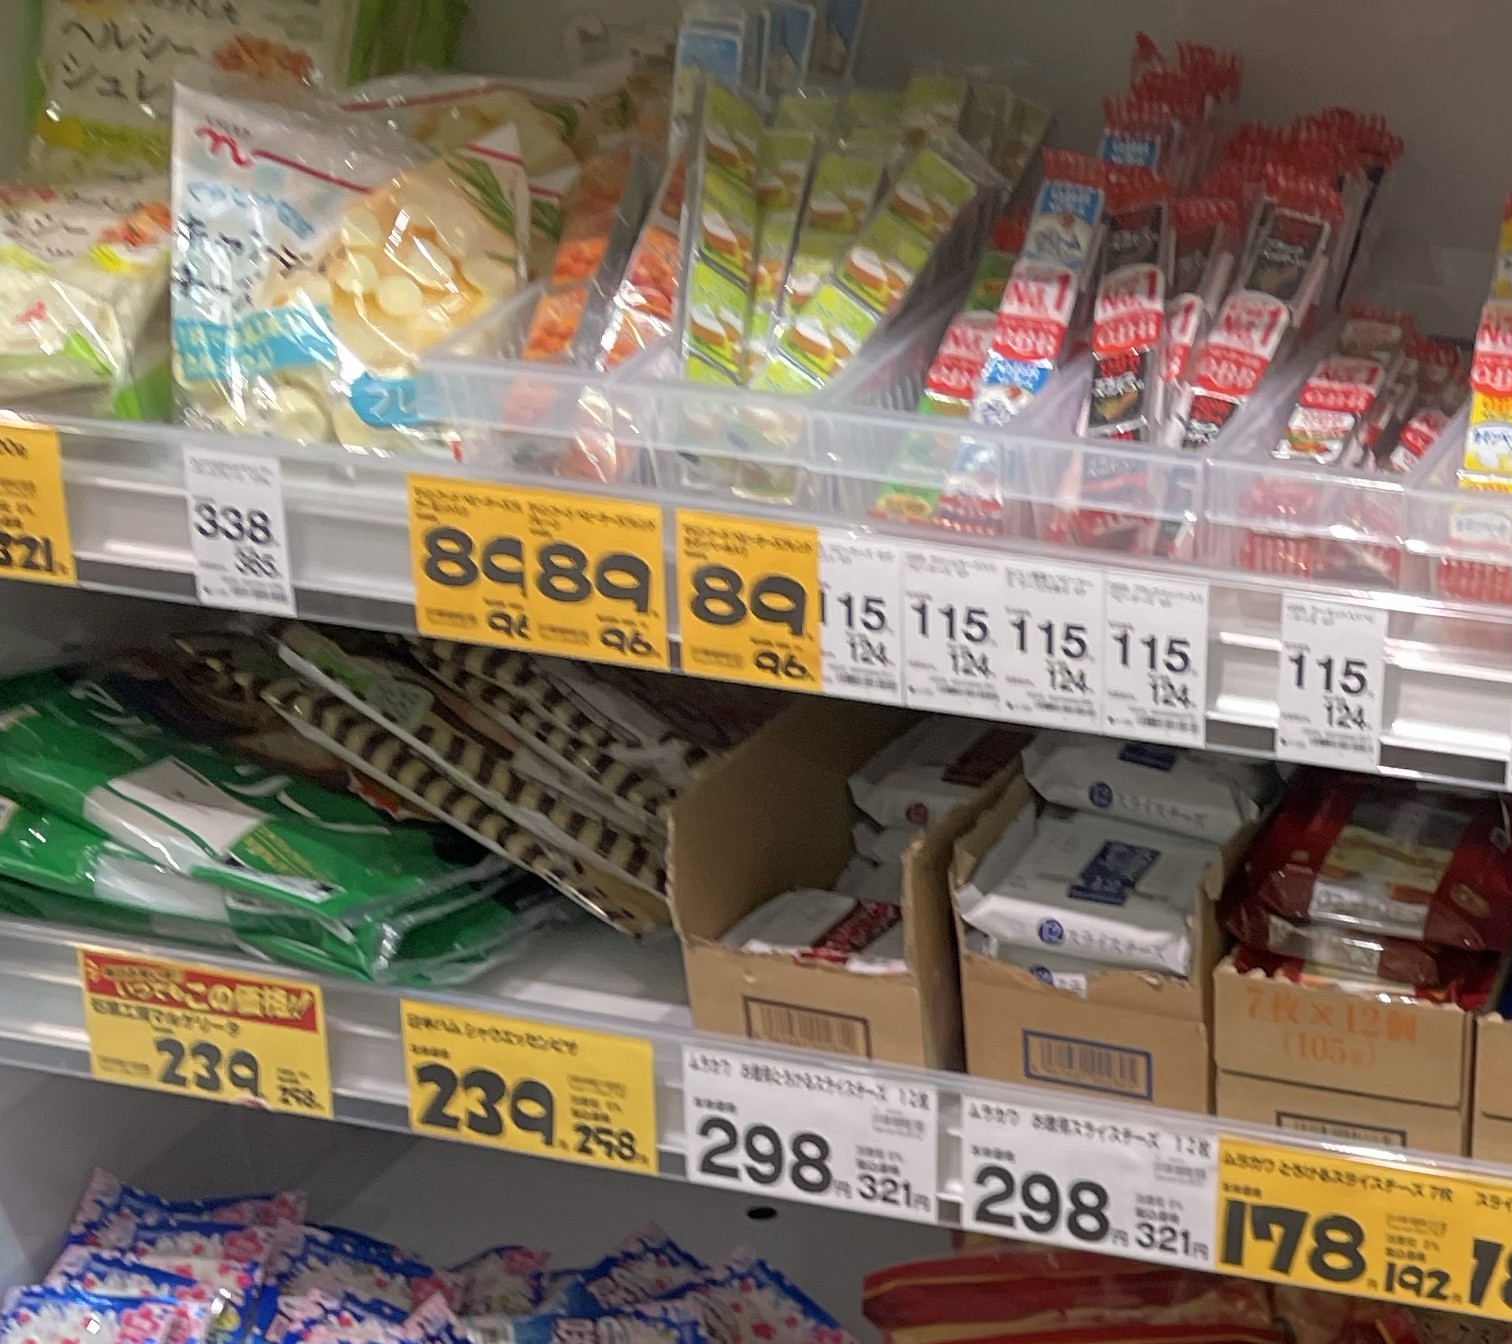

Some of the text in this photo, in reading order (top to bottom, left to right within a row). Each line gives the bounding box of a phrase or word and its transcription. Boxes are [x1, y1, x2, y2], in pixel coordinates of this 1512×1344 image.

[536, 542, 652, 614] 89
[690, 565, 807, 637] 89
[911, 601, 990, 643] 115
[1010, 614, 1089, 659] 115
[1111, 628, 1192, 673] 115
[1289, 652, 1368, 695] 115
[154, 1036, 260, 1098] 239
[414, 1062, 556, 1147] 239
